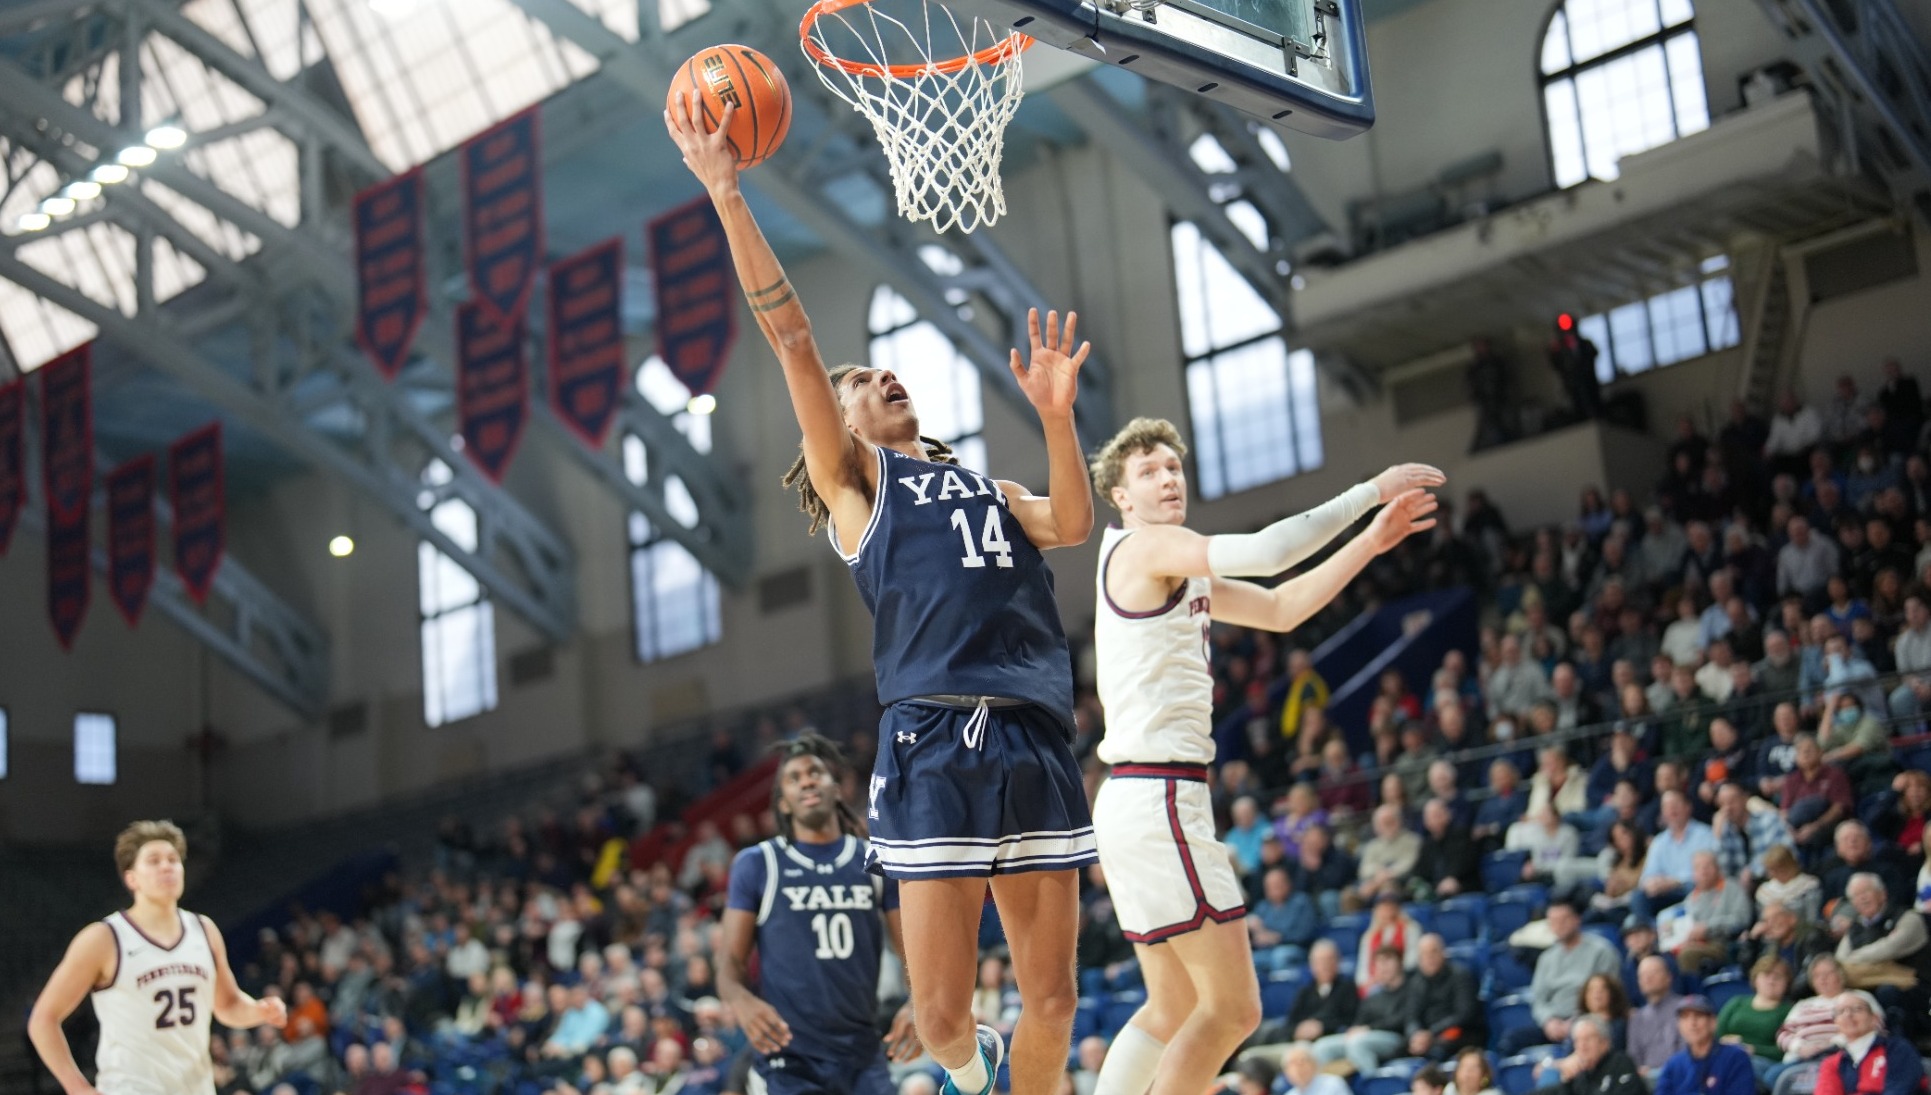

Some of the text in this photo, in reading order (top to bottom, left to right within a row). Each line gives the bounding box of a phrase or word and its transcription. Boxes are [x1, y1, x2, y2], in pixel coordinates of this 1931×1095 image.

[704, 54, 742, 109] ELITE
[950, 505, 1014, 568] 14
[868, 773, 887, 821] Y
[782, 885, 873, 911] YALE
[811, 912, 855, 960] 10
[154, 987, 196, 1029] 25
